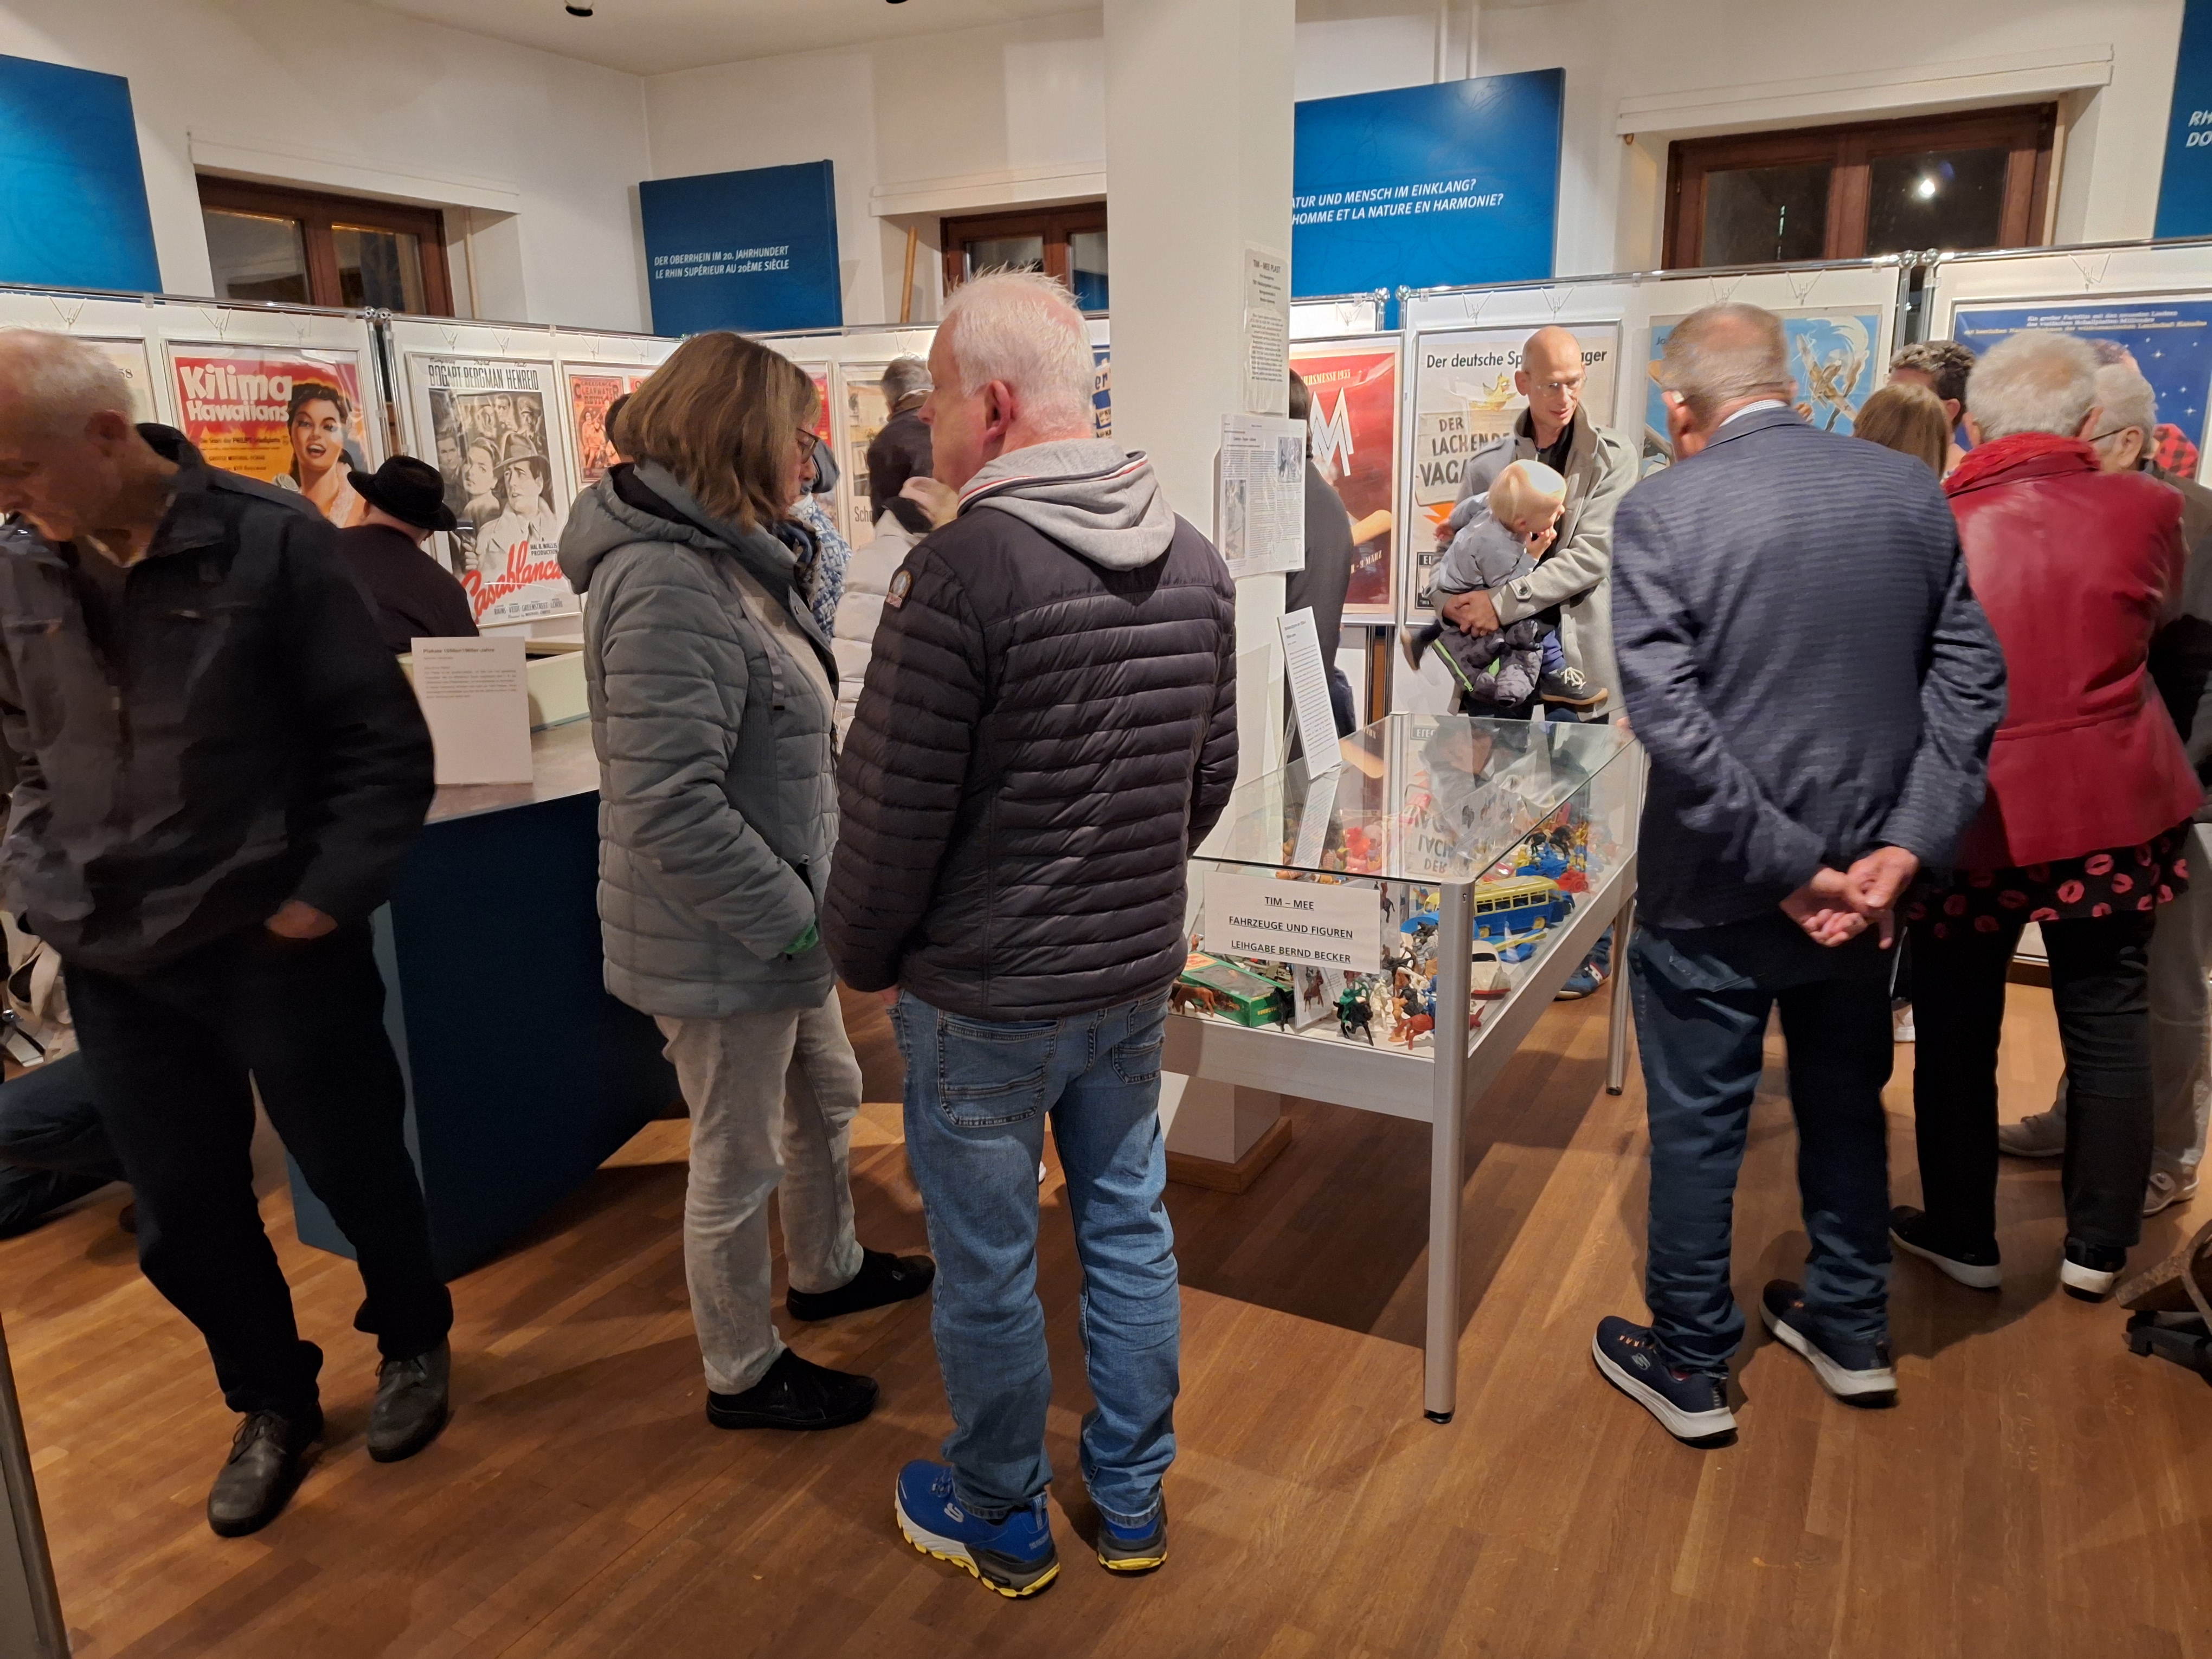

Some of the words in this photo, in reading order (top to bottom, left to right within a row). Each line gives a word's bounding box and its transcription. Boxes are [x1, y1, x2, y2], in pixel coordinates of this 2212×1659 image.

[1319, 192, 1342, 206] UND
[1345, 187, 1391, 204] MENSCH
[1394, 185, 1409, 199] IM
[1411, 178, 1476, 197] EINKLANG?
[1292, 209, 1334, 226] HOMME
[1336, 208, 1351, 222] ET
[1352, 207, 1365, 221] LA
[1367, 203, 1412, 218] NATURE
[1414, 201, 1430, 214] EN
[1433, 193, 1504, 211] HARMONIE?
[654, 255, 668, 266] DER
[670, 252, 711, 265] OBERRHEIN
[712, 251, 722, 261] IM
[735, 246, 789, 261] JAHRHUNDERT
[655, 269, 665, 280] LE
[665, 268, 682, 278] RHIN
[684, 264, 724, 277] SUPÉRIEUR
[725, 263, 736, 274] AU
[1427, 354, 1447, 368] Der
[1451, 351, 1504, 368] deutsche
[179, 364, 292, 401] Kilima
[428, 365, 461, 387] BOGART
[464, 366, 504, 389] BERGMAN
[506, 369, 539, 390] HENREID
[1338, 369, 1351, 381] 1955
[186, 400, 290, 422] Hawaiians
[1439, 417, 1464, 433] DER
[462, 541, 564, 624] Casablanca
[1265, 896, 1282, 906] TIM
[1294, 899, 1314, 910] MEE
[1229, 916, 1283, 930] FAHRZEUGE
[1287, 923, 1308, 933] UND
[1311, 926, 1353, 938] FIGUREN
[1231, 940, 1276, 954] LEIHGABE
[1279, 947, 1311, 957] BERND
[1314, 951, 1351, 963] BECKER
